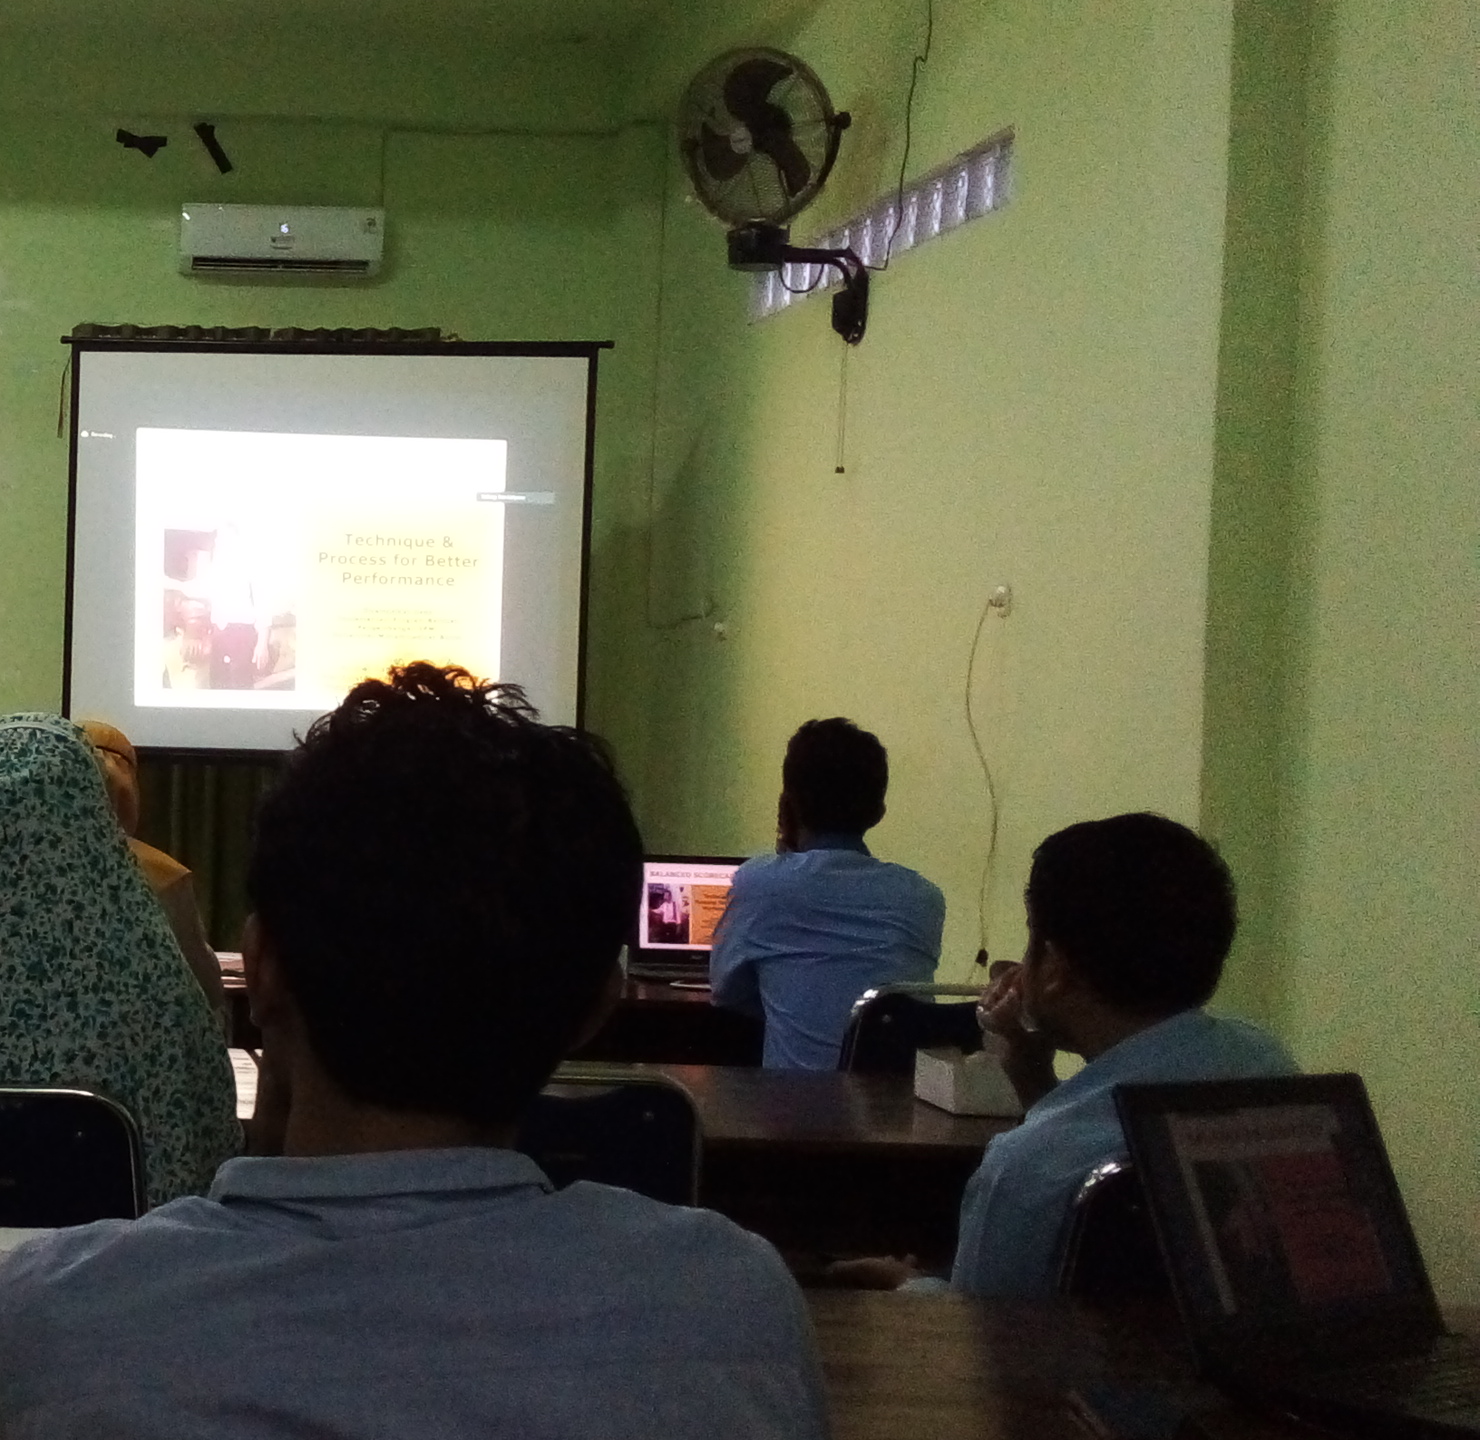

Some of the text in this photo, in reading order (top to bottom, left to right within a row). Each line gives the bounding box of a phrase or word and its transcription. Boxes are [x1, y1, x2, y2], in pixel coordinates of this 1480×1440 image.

[345, 533, 454, 550] Technique &
[319, 552, 479, 568] Process for Better
[342, 572, 455, 586] Performance
